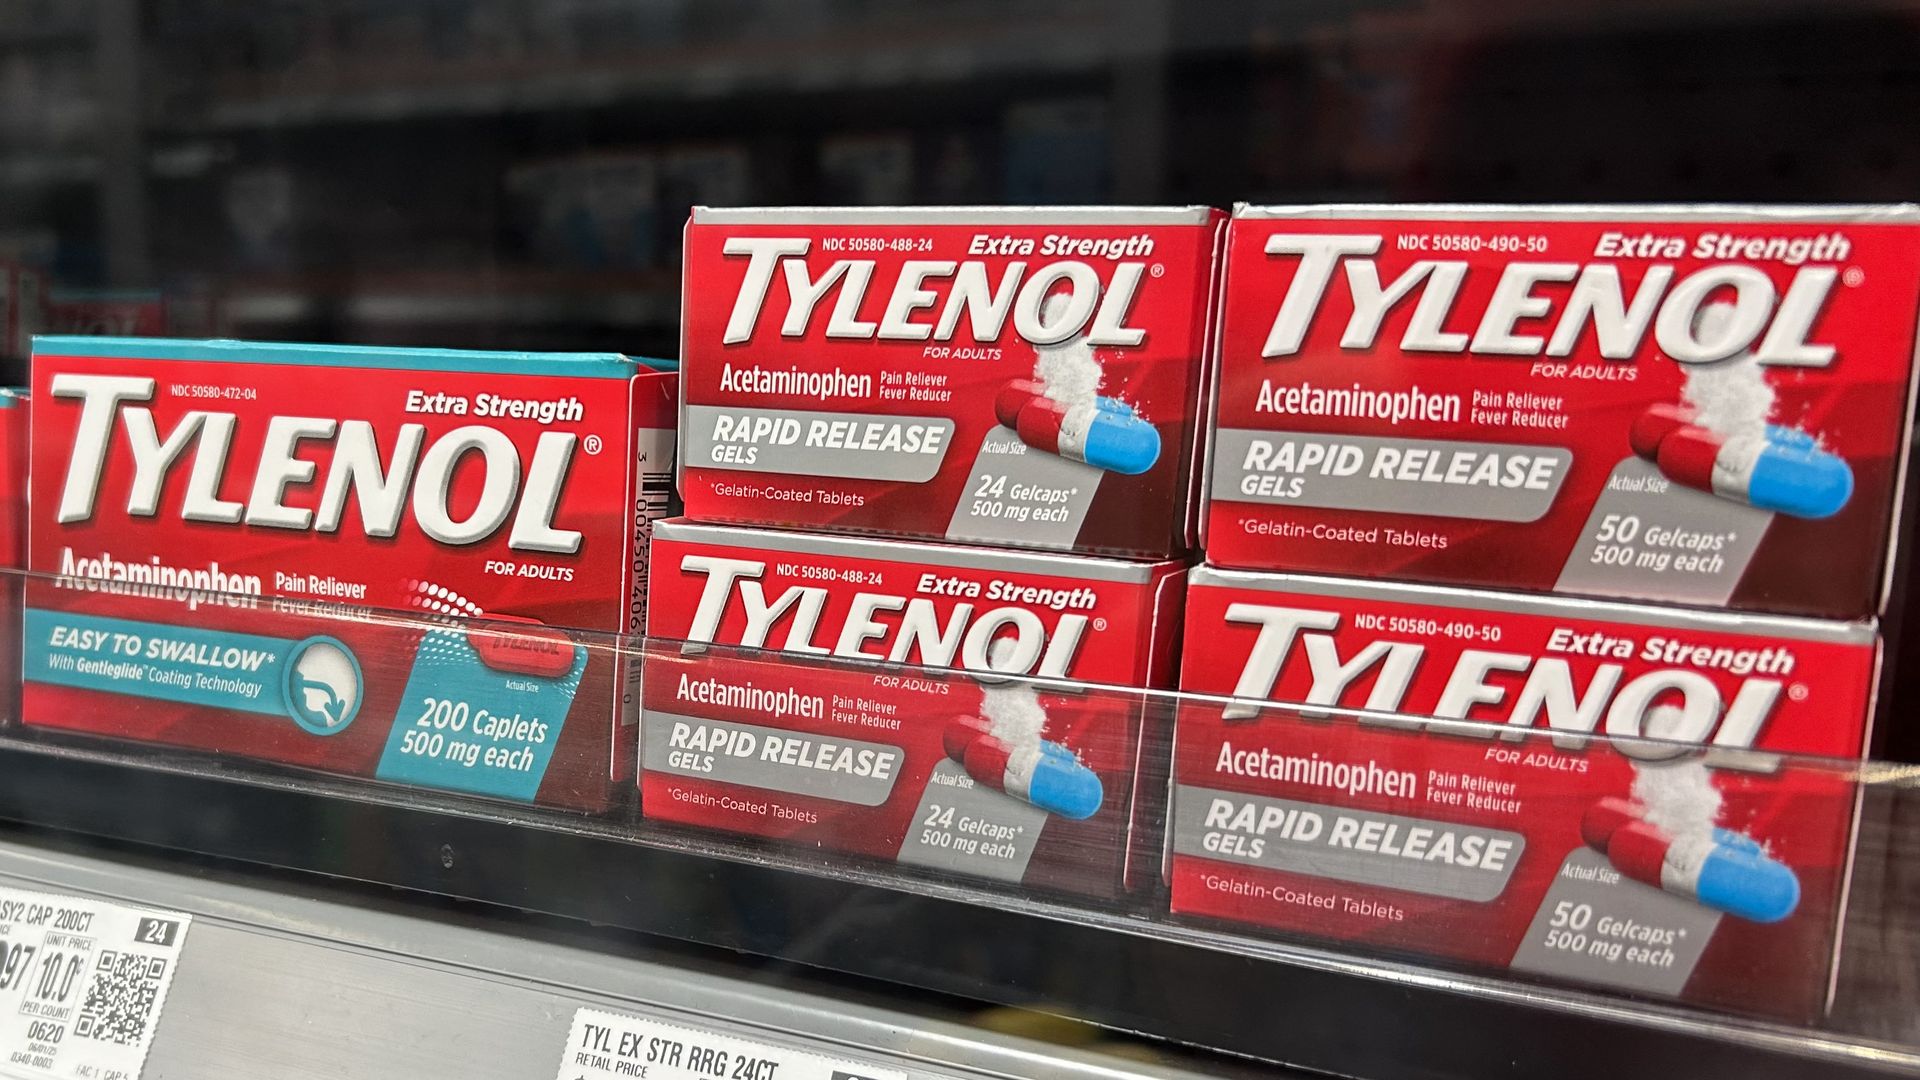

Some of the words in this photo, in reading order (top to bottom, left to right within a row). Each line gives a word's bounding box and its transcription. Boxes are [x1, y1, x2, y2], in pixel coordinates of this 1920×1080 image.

[823, 238, 845, 251] NDC
[848, 238, 933, 252] 50580-488-24
[968, 234, 1035, 256] Extra
[1039, 234, 1154, 260] Strength
[1397, 235, 1428, 250] NDC
[1432, 235, 1548, 252] 50580-490-50
[1594, 231, 1686, 258] Extra
[1692, 232, 1851, 265] Strength
[923, 347, 951, 359] FOR
[951, 348, 1002, 361] ADULTS
[719, 362, 872, 401] Acetaminophen
[881, 371, 902, 385] Pain
[905, 371, 947, 387] Reliever
[1530, 363, 1567, 378] FOR
[1569, 365, 1638, 381] ADULTS
[171, 384, 190, 397] NDC
[192, 385, 257, 400] 50580-472-04
[879, 385, 906, 400] Fever
[909, 386, 952, 402] Reducer
[1255, 379, 1460, 425] Acetaminophen
[1472, 390, 1502, 408] Pain
[1506, 391, 1563, 411] Reliever
[405, 390, 468, 415] Extra
[473, 393, 584, 424] Strength
[1470, 409, 1506, 425] Fever
[1511, 411, 1569, 429] Reducer
[712, 415, 801, 445] RAPID
[805, 420, 946, 454] RELEASE
[637, 452, 647, 462] 3
[711, 444, 758, 464] GELS
[982, 441, 1009, 454] Actual
[1009, 442, 1026, 455] Size
[1242, 439, 1364, 476] RAPID
[1369, 446, 1558, 490] RELEASE
[974, 474, 1007, 499] 24
[1240, 474, 1304, 498] GELS
[1608, 475, 1644, 491] Actual
[1644, 477, 1669, 493] Size
[816, 490, 865, 506] Tablets
[970, 500, 1002, 517] 500
[1004, 504, 1030, 522] mg
[1032, 505, 1069, 522] each
[633, 499, 647, 574] 00450
[1383, 528, 1448, 549] Tablets
[1595, 514, 1640, 543] 50
[484, 560, 516, 576] FOR
[517, 563, 575, 581] ADULTS
[1590, 545, 1634, 565] 500
[1635, 550, 1671, 572] mg
[1673, 553, 1724, 573] each
[54, 547, 262, 610] Acetaminophen
[275, 571, 306, 593] Pain
[309, 574, 367, 599] Reliever
[777, 563, 799, 577] NDC
[801, 565, 883, 585] 50580-488-24
[916, 573, 981, 598] Extra
[985, 579, 1097, 610] Strength
[50, 625, 110, 650] EASY
[112, 633, 142, 656] TO
[1355, 614, 1386, 631] NDC
[1389, 617, 1501, 642] 50580-490-50
[1546, 627, 1634, 658] Extra
[1639, 637, 1795, 675] Strength
[49, 653, 74, 672] With
[149, 667, 191, 689] Coating
[195, 672, 263, 698] Technology
[506, 680, 521, 690] Actual
[521, 682, 539, 693] Size
[873, 675, 900, 688] FOR
[902, 678, 950, 695] ADULTS
[676, 673, 824, 719] Acetaminophen
[832, 695, 854, 709] Pain
[856, 698, 897, 715] Reliever
[417, 697, 470, 732] 200
[472, 709, 549, 744] Caplets
[831, 709, 858, 724] Fever
[860, 712, 901, 730] Reducer
[400, 730, 443, 758] 500
[446, 739, 481, 768] mg
[484, 747, 534, 772] each
[668, 751, 715, 773] GELS
[669, 722, 757, 758] RAPID
[760, 736, 895, 780] RELEASE
[1485, 748, 1520, 763] FOR
[1522, 753, 1589, 773] ADULTS
[931, 771, 957, 786] Actual
[957, 775, 974, 789] Size
[1216, 741, 1417, 799] Acetaminophen
[1428, 770, 1457, 789] Pain
[1461, 774, 1516, 795] Reliever
[1427, 787, 1462, 806] Fever
[1466, 791, 1522, 814] Reducer
[771, 804, 817, 824] Tablets
[924, 804, 955, 829] 24
[920, 829, 951, 847] 500
[952, 837, 978, 855] mg
[980, 843, 1015, 859] each
[1203, 832, 1265, 859] GELS
[1204, 798, 1323, 841] RAPID
[1328, 816, 1512, 872] RELEASE
[1561, 863, 1597, 880] Actual
[1597, 868, 1620, 884] Size
[0, 900, 25, 922] SY2
[27, 904, 53, 925] CAP
[54, 908, 95, 932] 200CT
[1341, 897, 1404, 921] Tablets
[1549, 900, 1592, 930] 50
[47, 934, 67, 947] UNIT
[68, 937, 92, 951] PRICE
[144, 919, 169, 944] 24
[1543, 929, 1587, 952] 500
[1587, 940, 1623, 961] mg
[1625, 949, 1675, 967] each
[0, 940, 36, 991] 97
[23, 1001, 40, 1013] PER
[41, 1004, 70, 1019] COUNT
[27, 1020, 64, 1044] 0620
[582, 1023, 611, 1053] TYL
[618, 1032, 644, 1058] EX
[647, 1037, 683, 1067] STR
[687, 1045, 728, 1077] RRG
[731, 1055, 779, 1080] 24CT
[575, 1052, 611, 1071] RETAIL
[615, 1061, 648, 1079] PRICE
